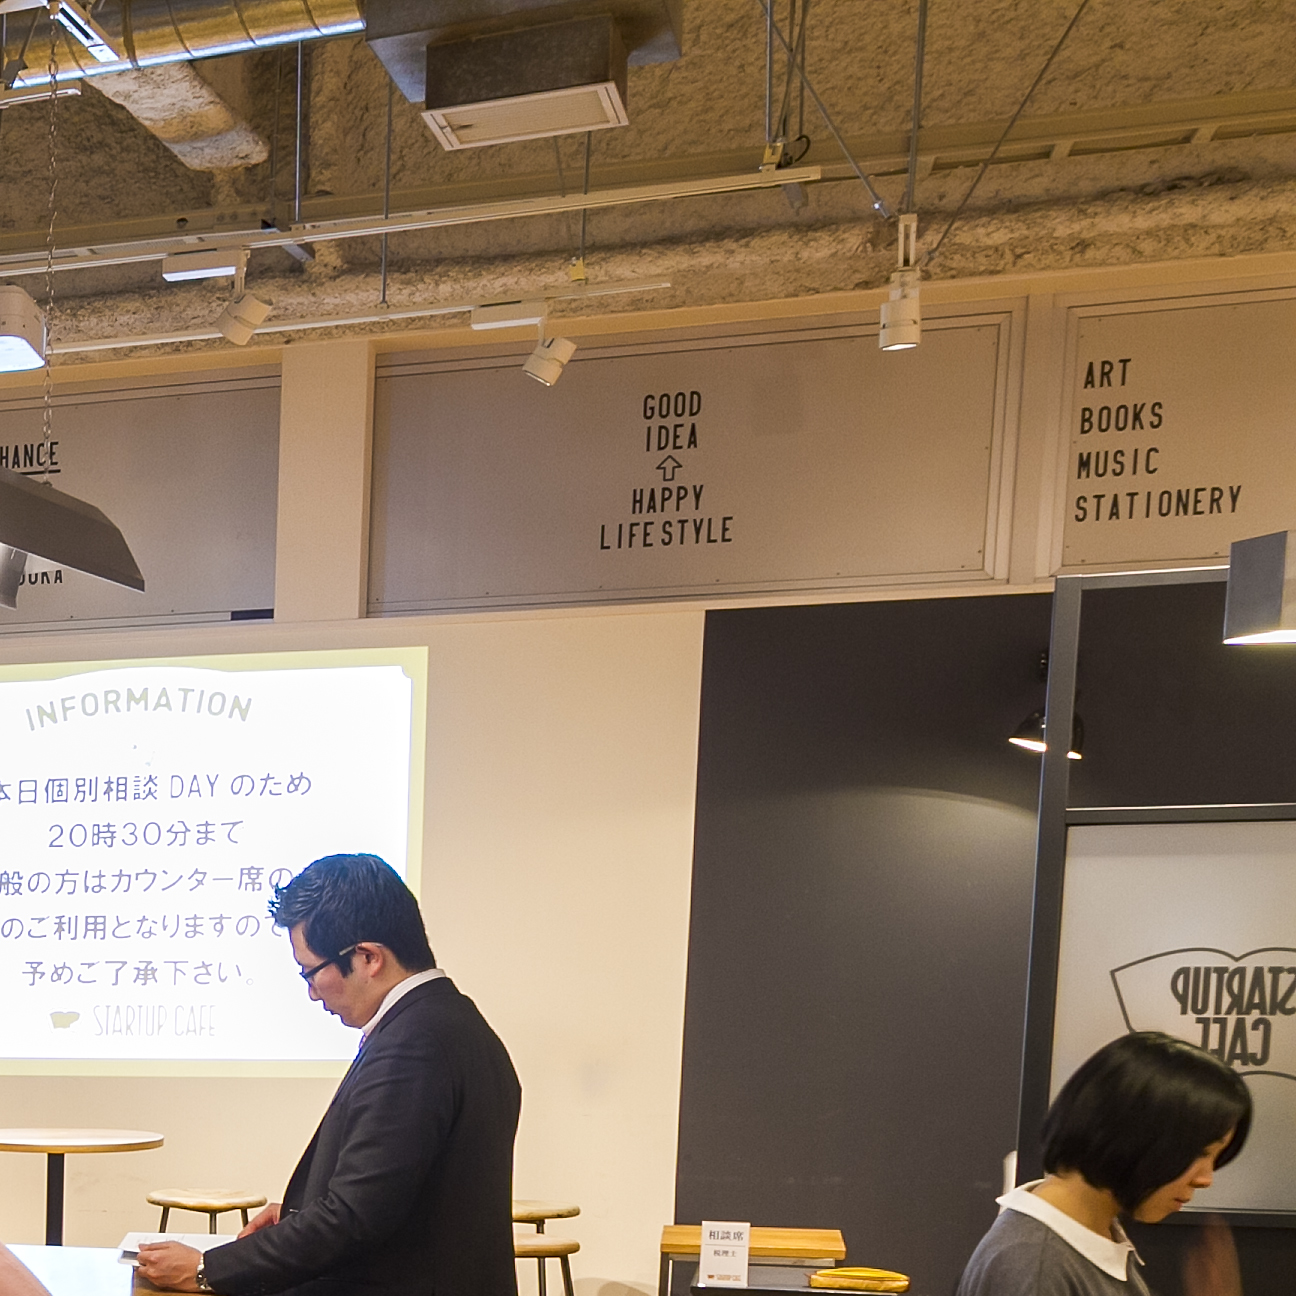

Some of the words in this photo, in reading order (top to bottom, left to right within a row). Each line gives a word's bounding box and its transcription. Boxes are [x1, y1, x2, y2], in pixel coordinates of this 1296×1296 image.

[1084, 358, 1132, 390] ART
[643, 390, 703, 421] GOOD
[1080, 402, 1164, 435] BOOKS
[645, 423, 699, 453] IDEA
[1076, 447, 1160, 480] MUSIC
[632, 484, 705, 516] HAPPY
[1074, 485, 1243, 523] STATIONERY
[600, 516, 734, 551] LIFESTYLE
[25, 687, 252, 731] INFORMATION
[170, 775, 219, 798] DAY
[230, 773, 312, 797] のため
[22, 961, 254, 987] 予めご了承下さい。
[94, 1006, 167, 1038] STARTUP
[174, 1005, 216, 1036] CAFE
[709, 1230, 744, 1241] 相談席
